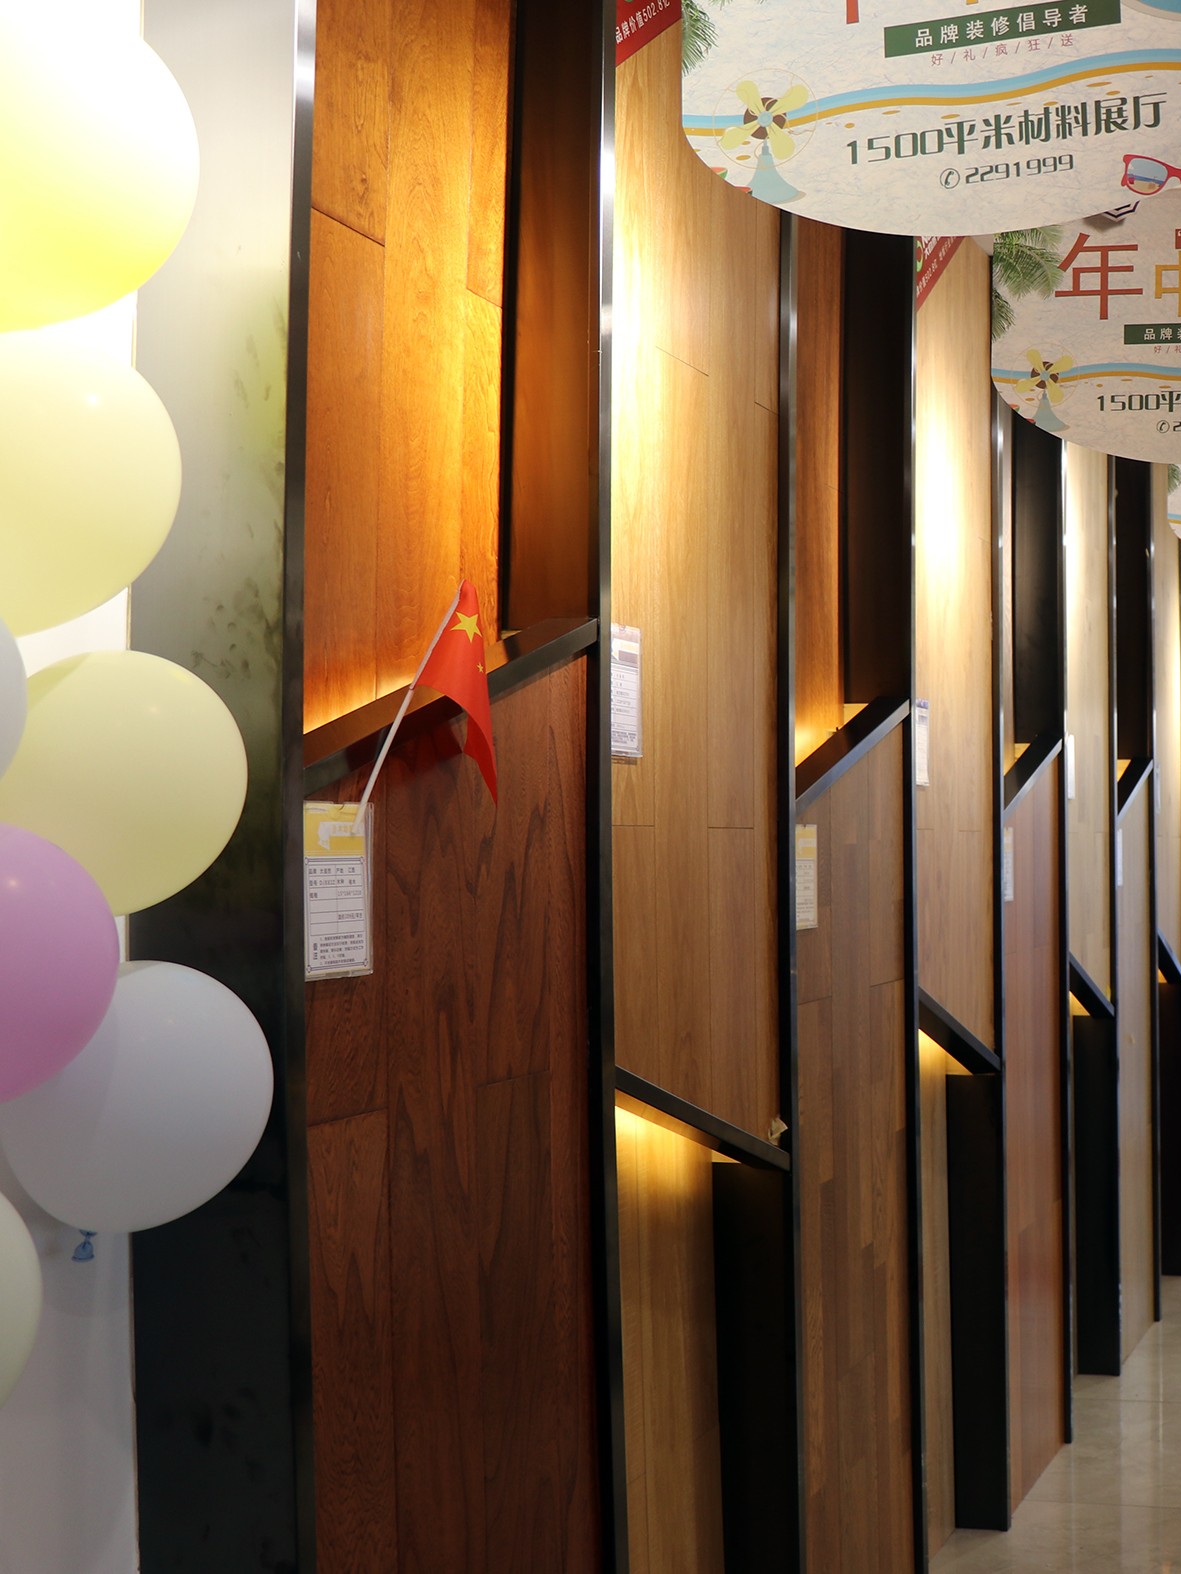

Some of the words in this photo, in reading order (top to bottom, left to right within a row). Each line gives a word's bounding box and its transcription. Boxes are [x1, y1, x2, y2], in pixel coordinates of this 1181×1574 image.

[914, 4, 1089, 48] 品牌装修倡导者
[846, 92, 1167, 165] 1500平米材料展厅
[965, 154, 1074, 185] 2291999
